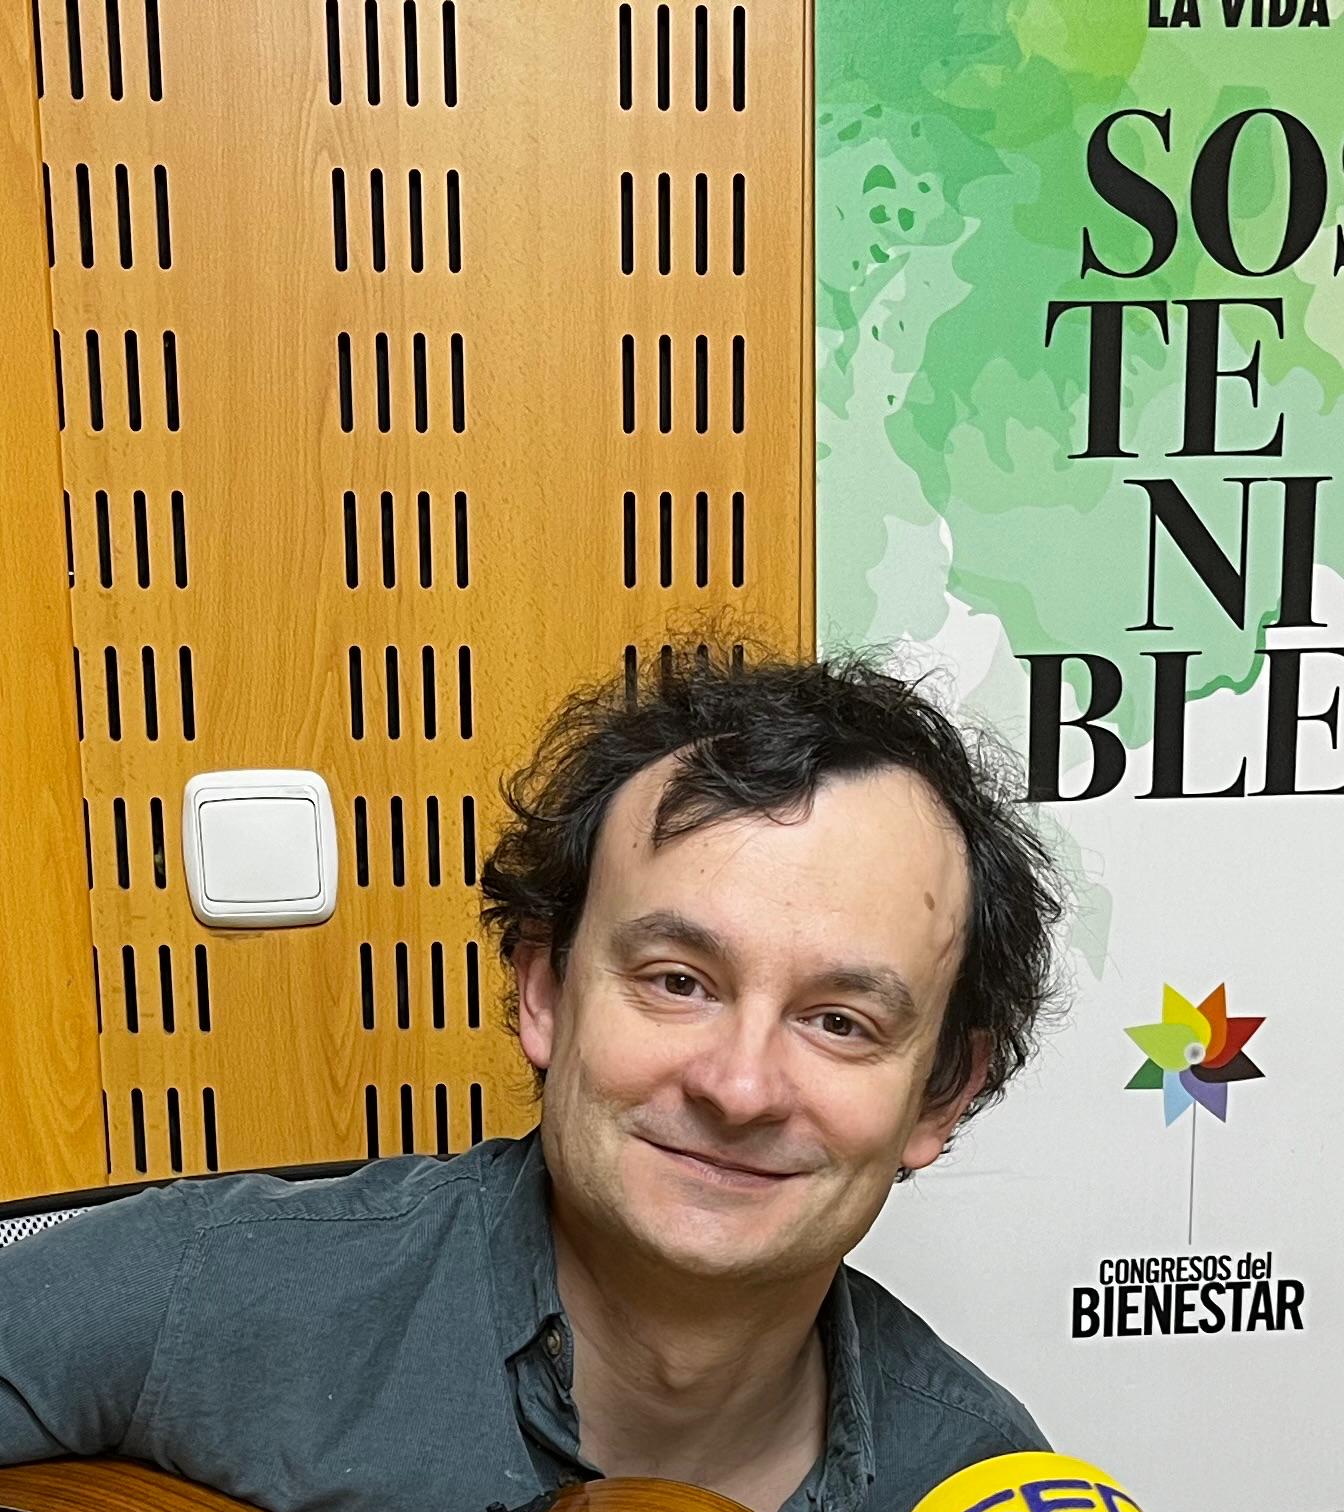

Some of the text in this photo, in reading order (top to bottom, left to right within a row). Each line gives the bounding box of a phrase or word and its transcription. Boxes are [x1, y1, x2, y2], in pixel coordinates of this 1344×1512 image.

[1148, 0, 1330, 27] LA VIDA
[1044, 297, 1284, 459] TE
[1123, 476, 1333, 632] NI
[1099, 1251, 1272, 1285] CONGRESOS del
[1072, 1279, 1305, 1338] BIENESTAR
